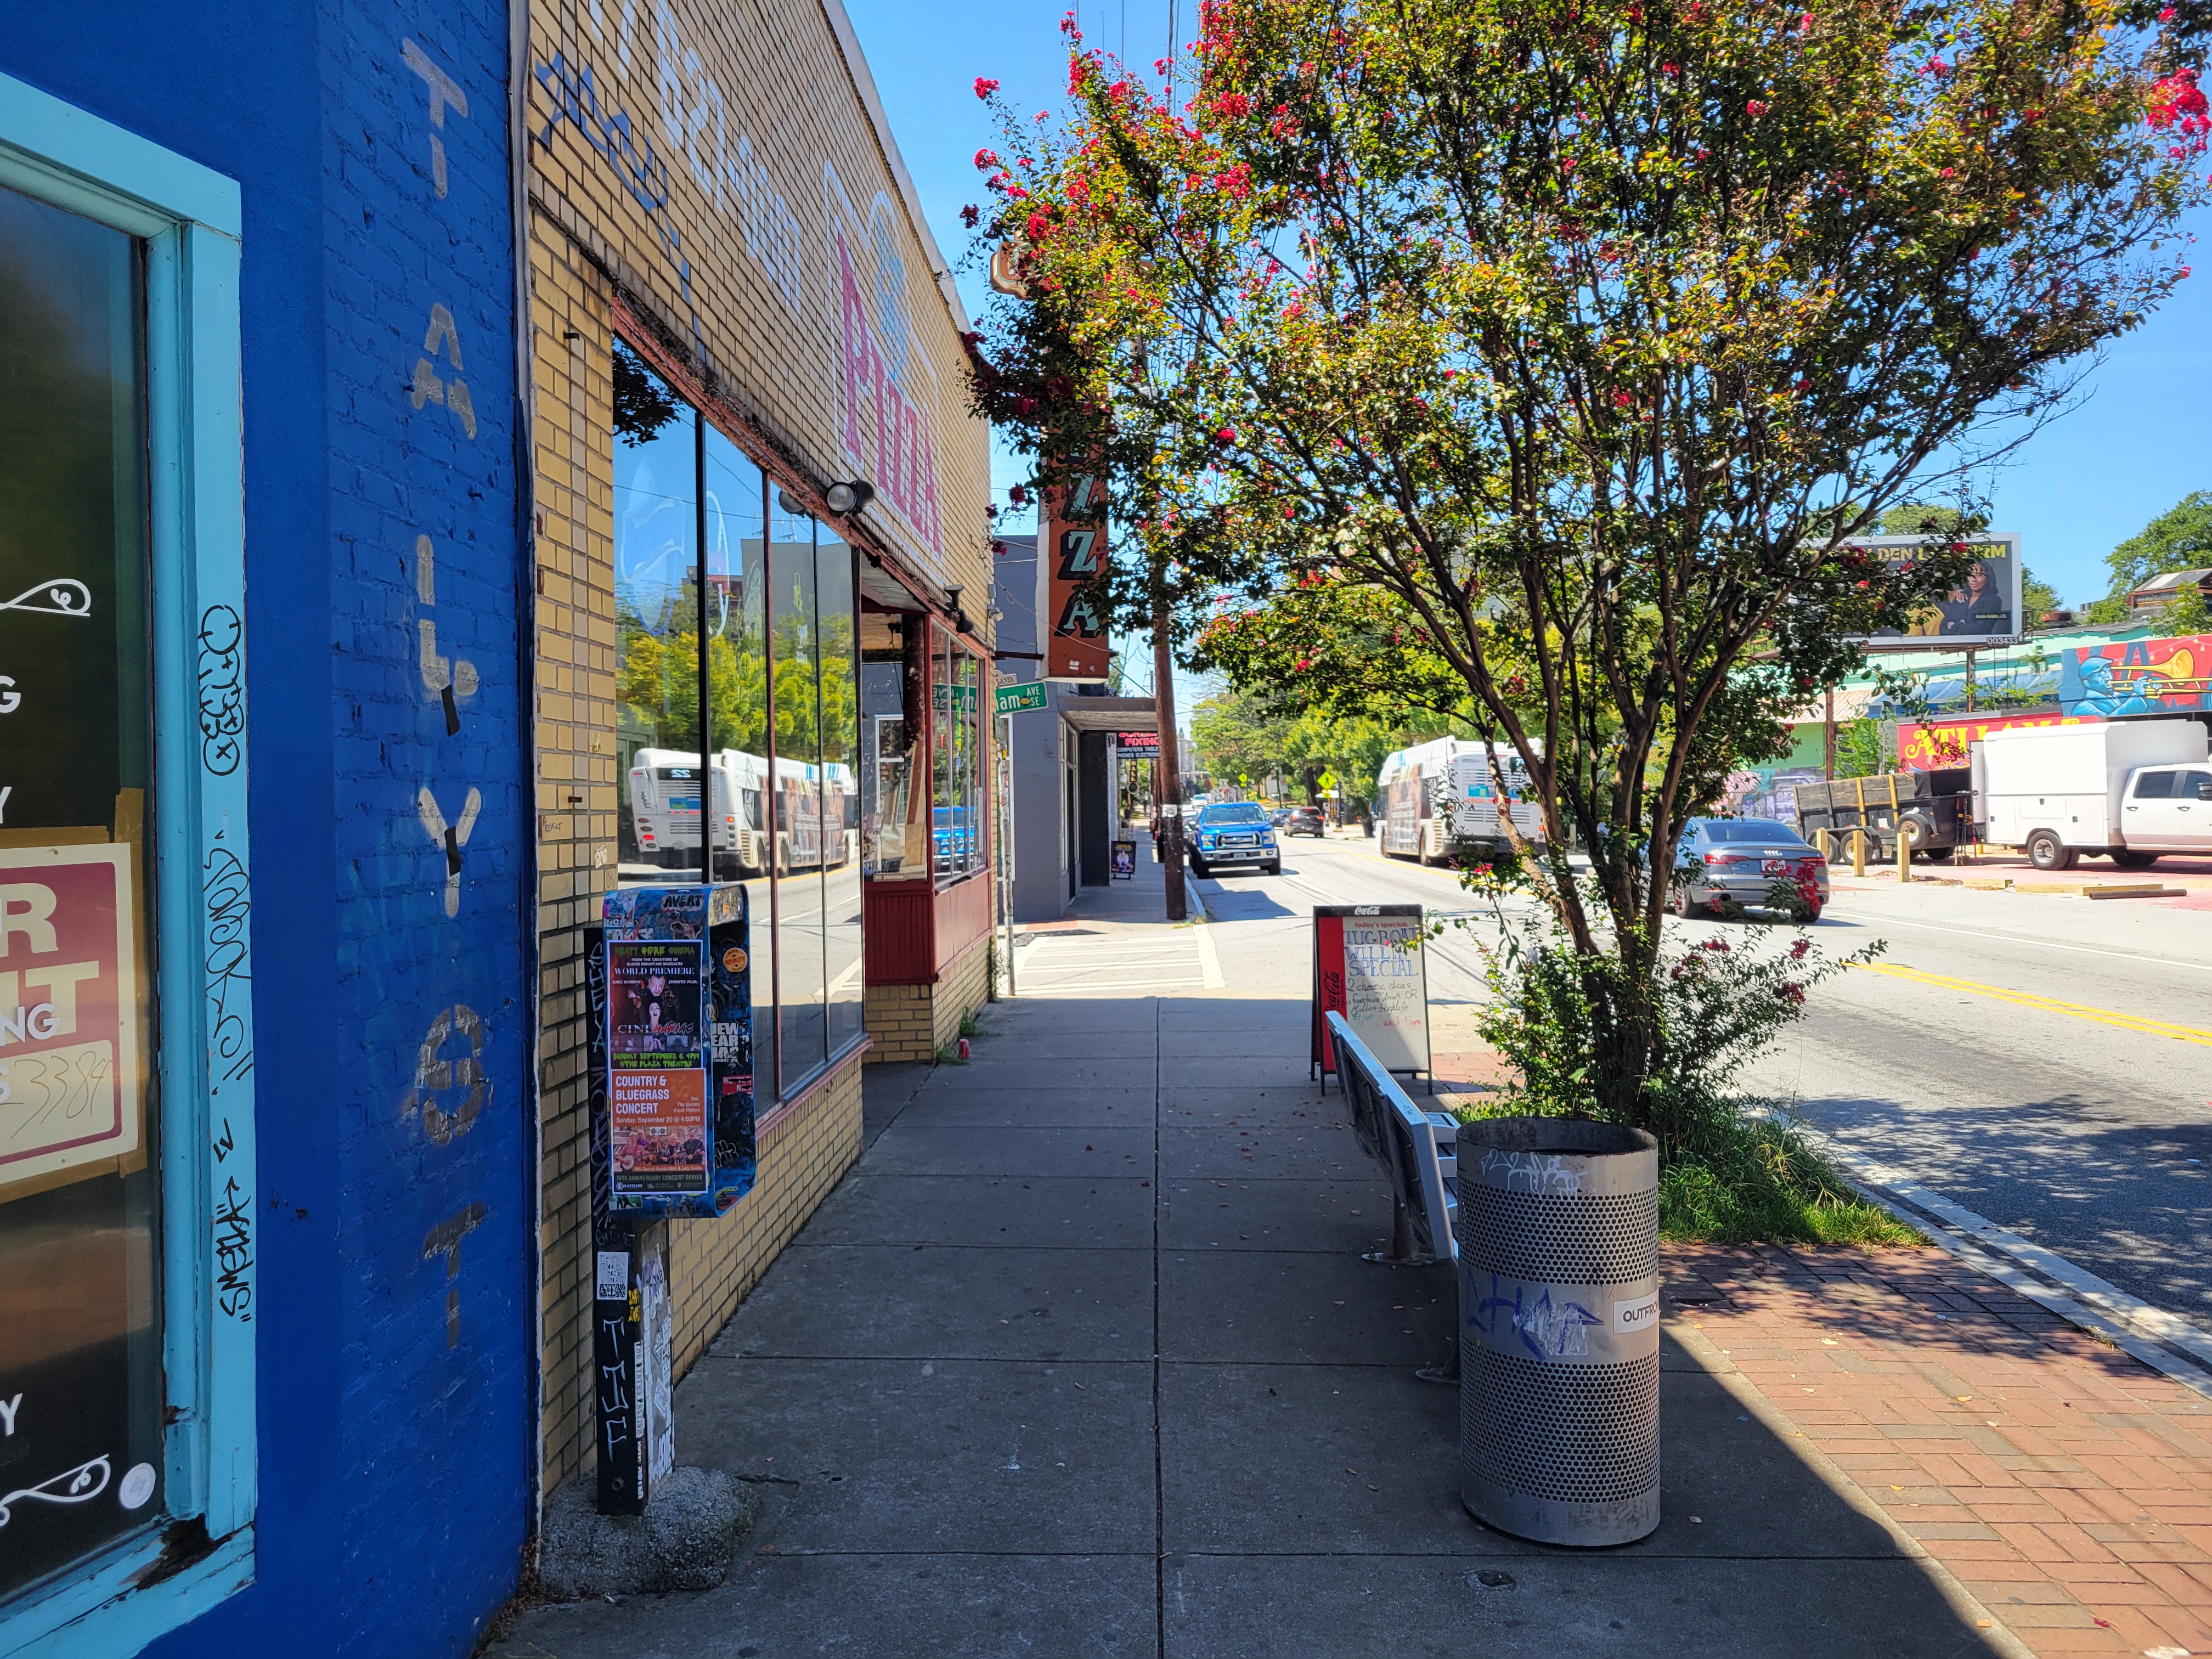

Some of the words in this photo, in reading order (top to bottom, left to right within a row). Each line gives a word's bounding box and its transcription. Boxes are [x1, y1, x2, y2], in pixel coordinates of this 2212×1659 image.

[835, 217, 944, 560] PIZZA
[996, 695, 1021, 712] am
[1026, 686, 1041, 697] AVE
[1030, 697, 1040, 706] SE
[1344, 930, 1376, 945] TUG
[641, 946, 665, 957] OGRE
[1349, 960, 1418, 977] SPECIAL
[1346, 978, 1355, 991] 2
[1388, 979, 1411, 990] slices
[1405, 989, 1418, 999] OR
[618, 1022, 694, 1035] CINEMANIAC
[616, 1075, 657, 1087] COUNTRY
[659, 1075, 667, 1086] &
[616, 1088, 670, 1101] BLUEGRASS
[616, 1103, 658, 1114] CONCERT
